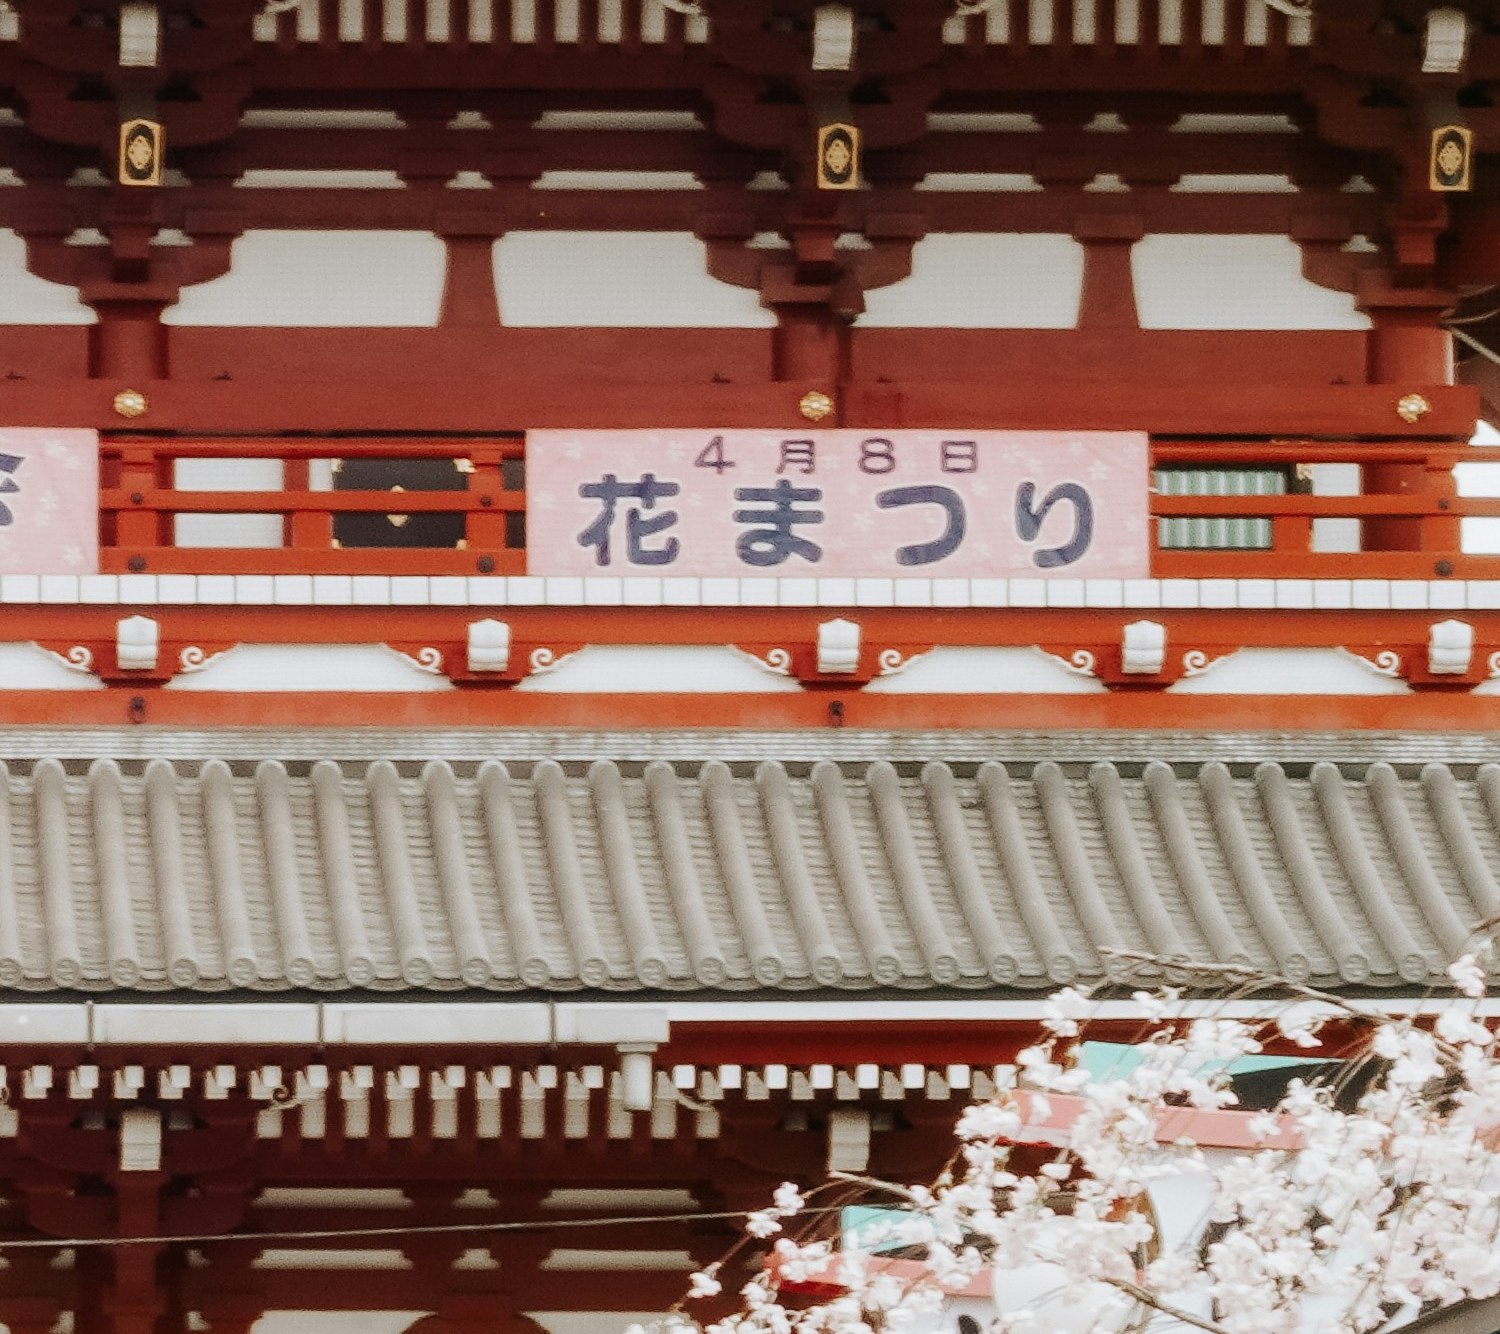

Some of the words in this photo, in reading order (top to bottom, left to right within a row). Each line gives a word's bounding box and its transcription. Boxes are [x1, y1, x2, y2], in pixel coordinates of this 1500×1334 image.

[694, 436, 979, 474] 4月8日
[577, 473, 1094, 568] 花まつり
